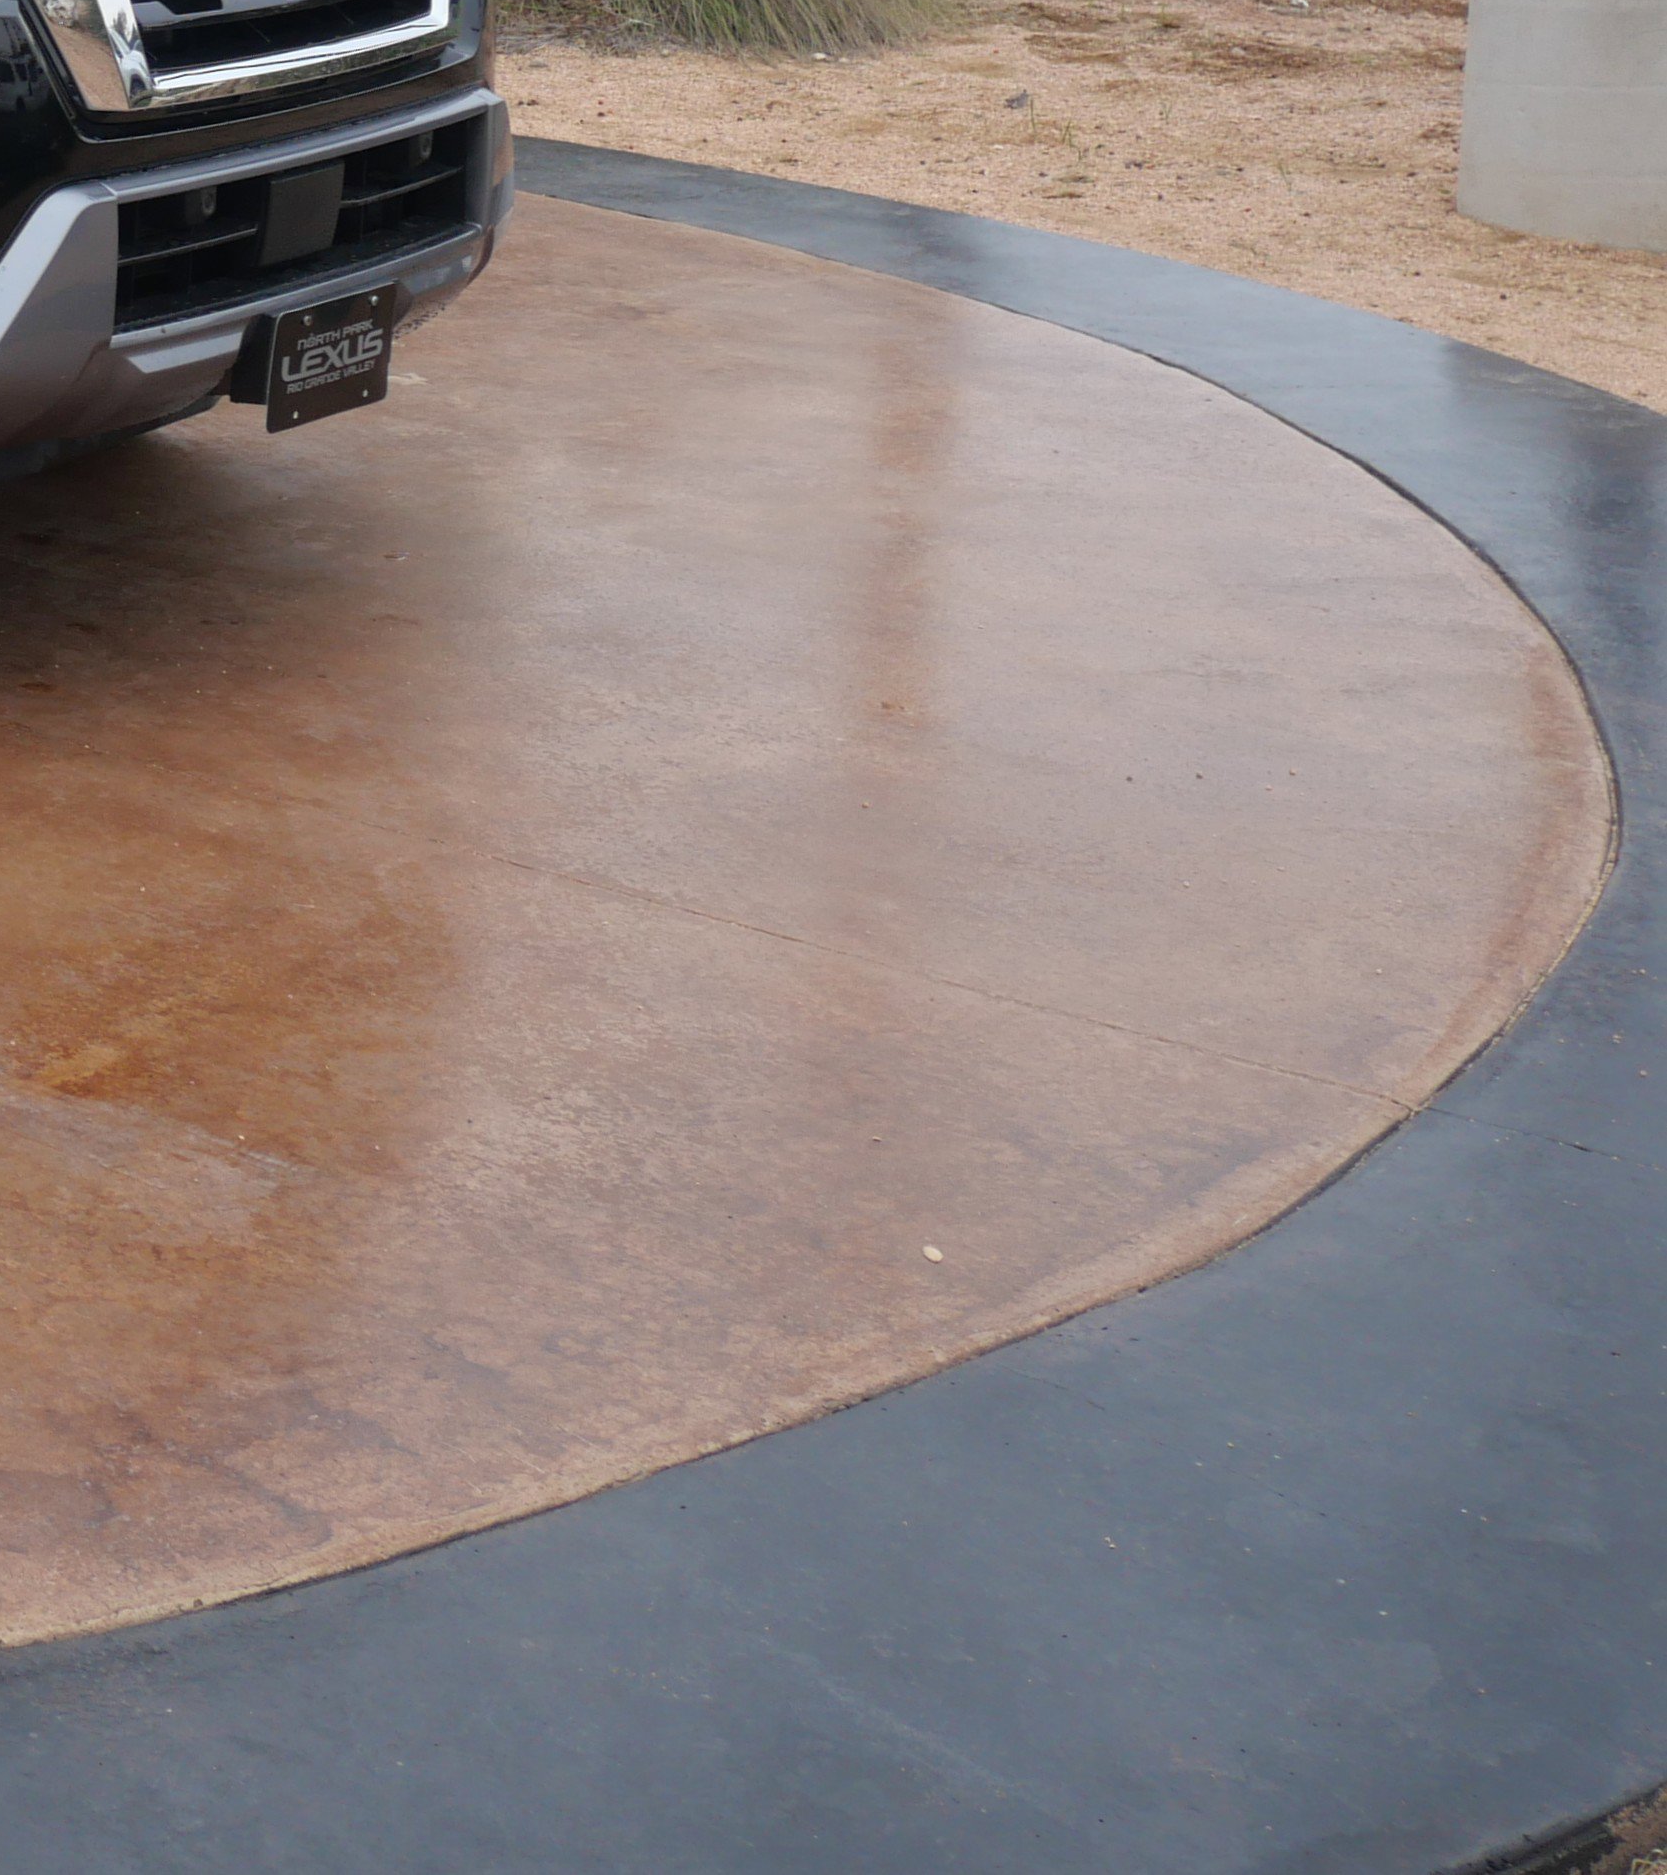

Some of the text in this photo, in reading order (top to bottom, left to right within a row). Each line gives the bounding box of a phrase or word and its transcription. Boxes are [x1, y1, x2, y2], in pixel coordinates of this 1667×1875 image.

[297, 319, 374, 351] NORTH PARK
[282, 329, 384, 382] LEXUS
[286, 359, 376, 395] RIO GRANDE VALLEY
